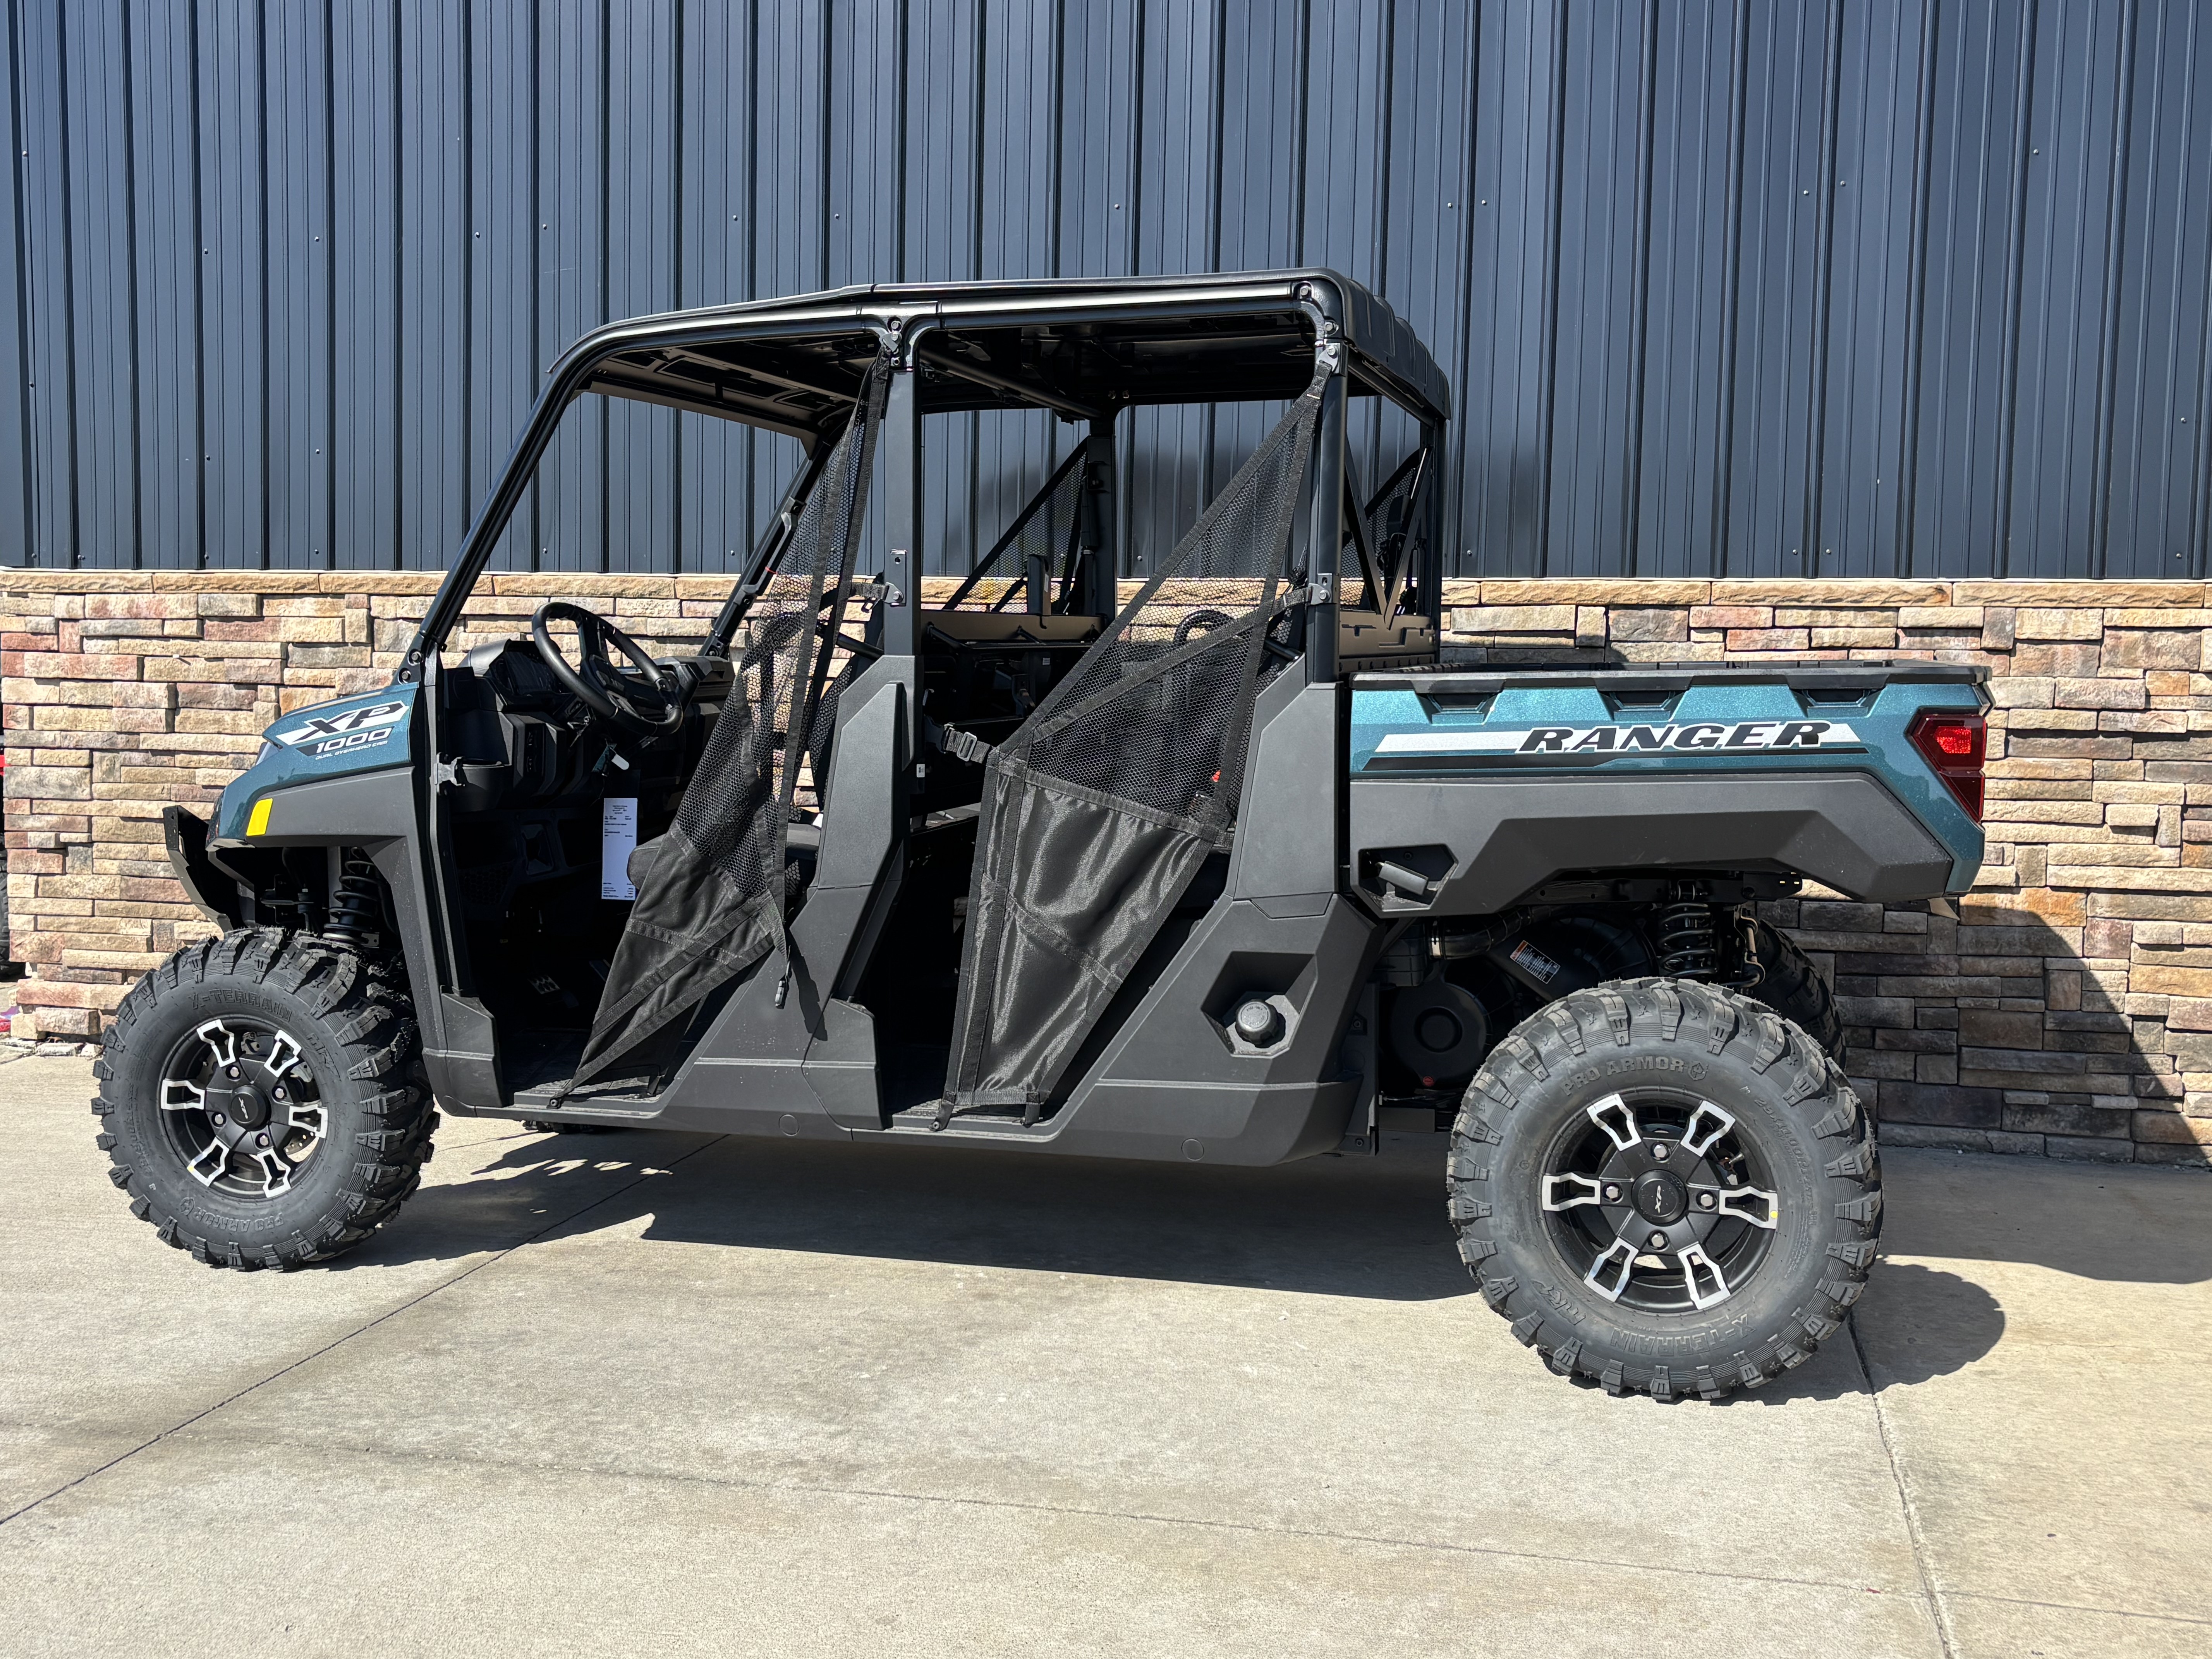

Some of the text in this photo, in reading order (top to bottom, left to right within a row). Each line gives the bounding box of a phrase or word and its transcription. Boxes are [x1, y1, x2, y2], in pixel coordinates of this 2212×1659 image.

[294, 702, 404, 742] XP
[1519, 721, 1831, 753] RANGER
[316, 727, 392, 754] 1000
[335, 744, 371, 756] OVERHEAD
[190, 989, 292, 1022] X-TERRAIN
[1562, 1056, 1687, 1096] PRO ARMOR
[194, 1205, 285, 1232] PRO ARMOR
[1610, 1314, 1757, 1356] X-TERRAIN
